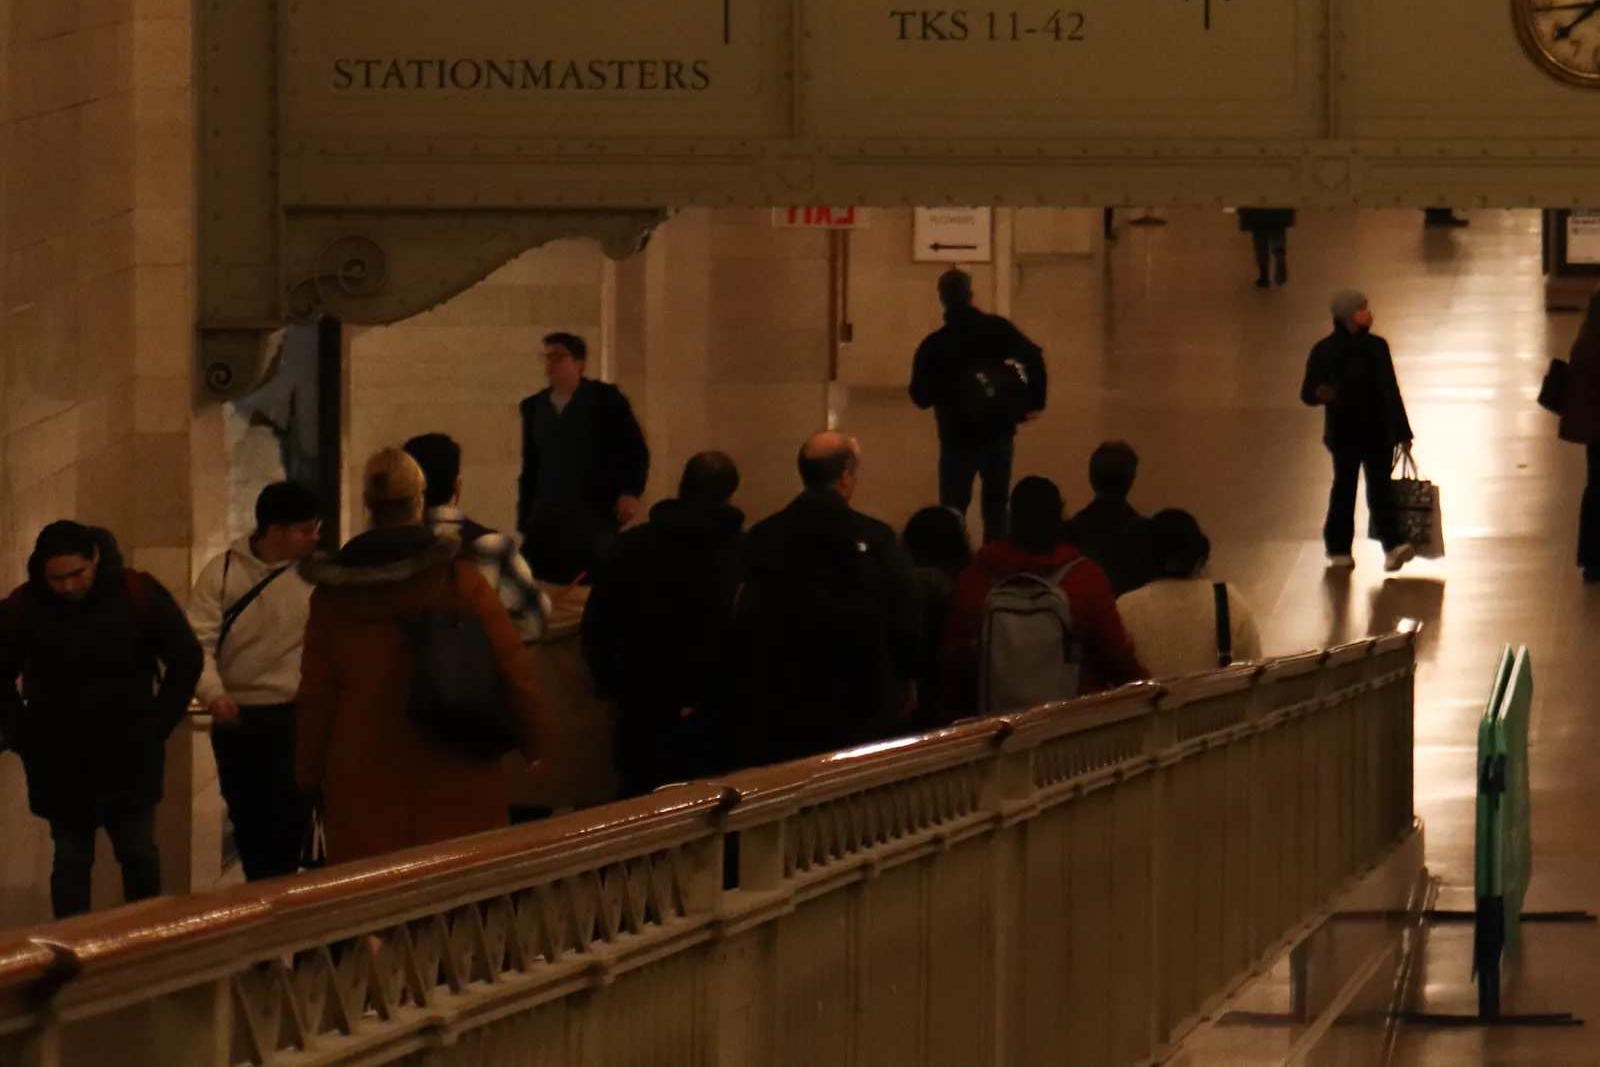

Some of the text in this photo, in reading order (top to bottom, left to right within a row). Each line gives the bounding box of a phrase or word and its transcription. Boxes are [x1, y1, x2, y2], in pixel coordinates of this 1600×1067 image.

[889, 9, 1085, 42] TKS 11-42
[333, 58, 711, 91] STATIONMASTERS
